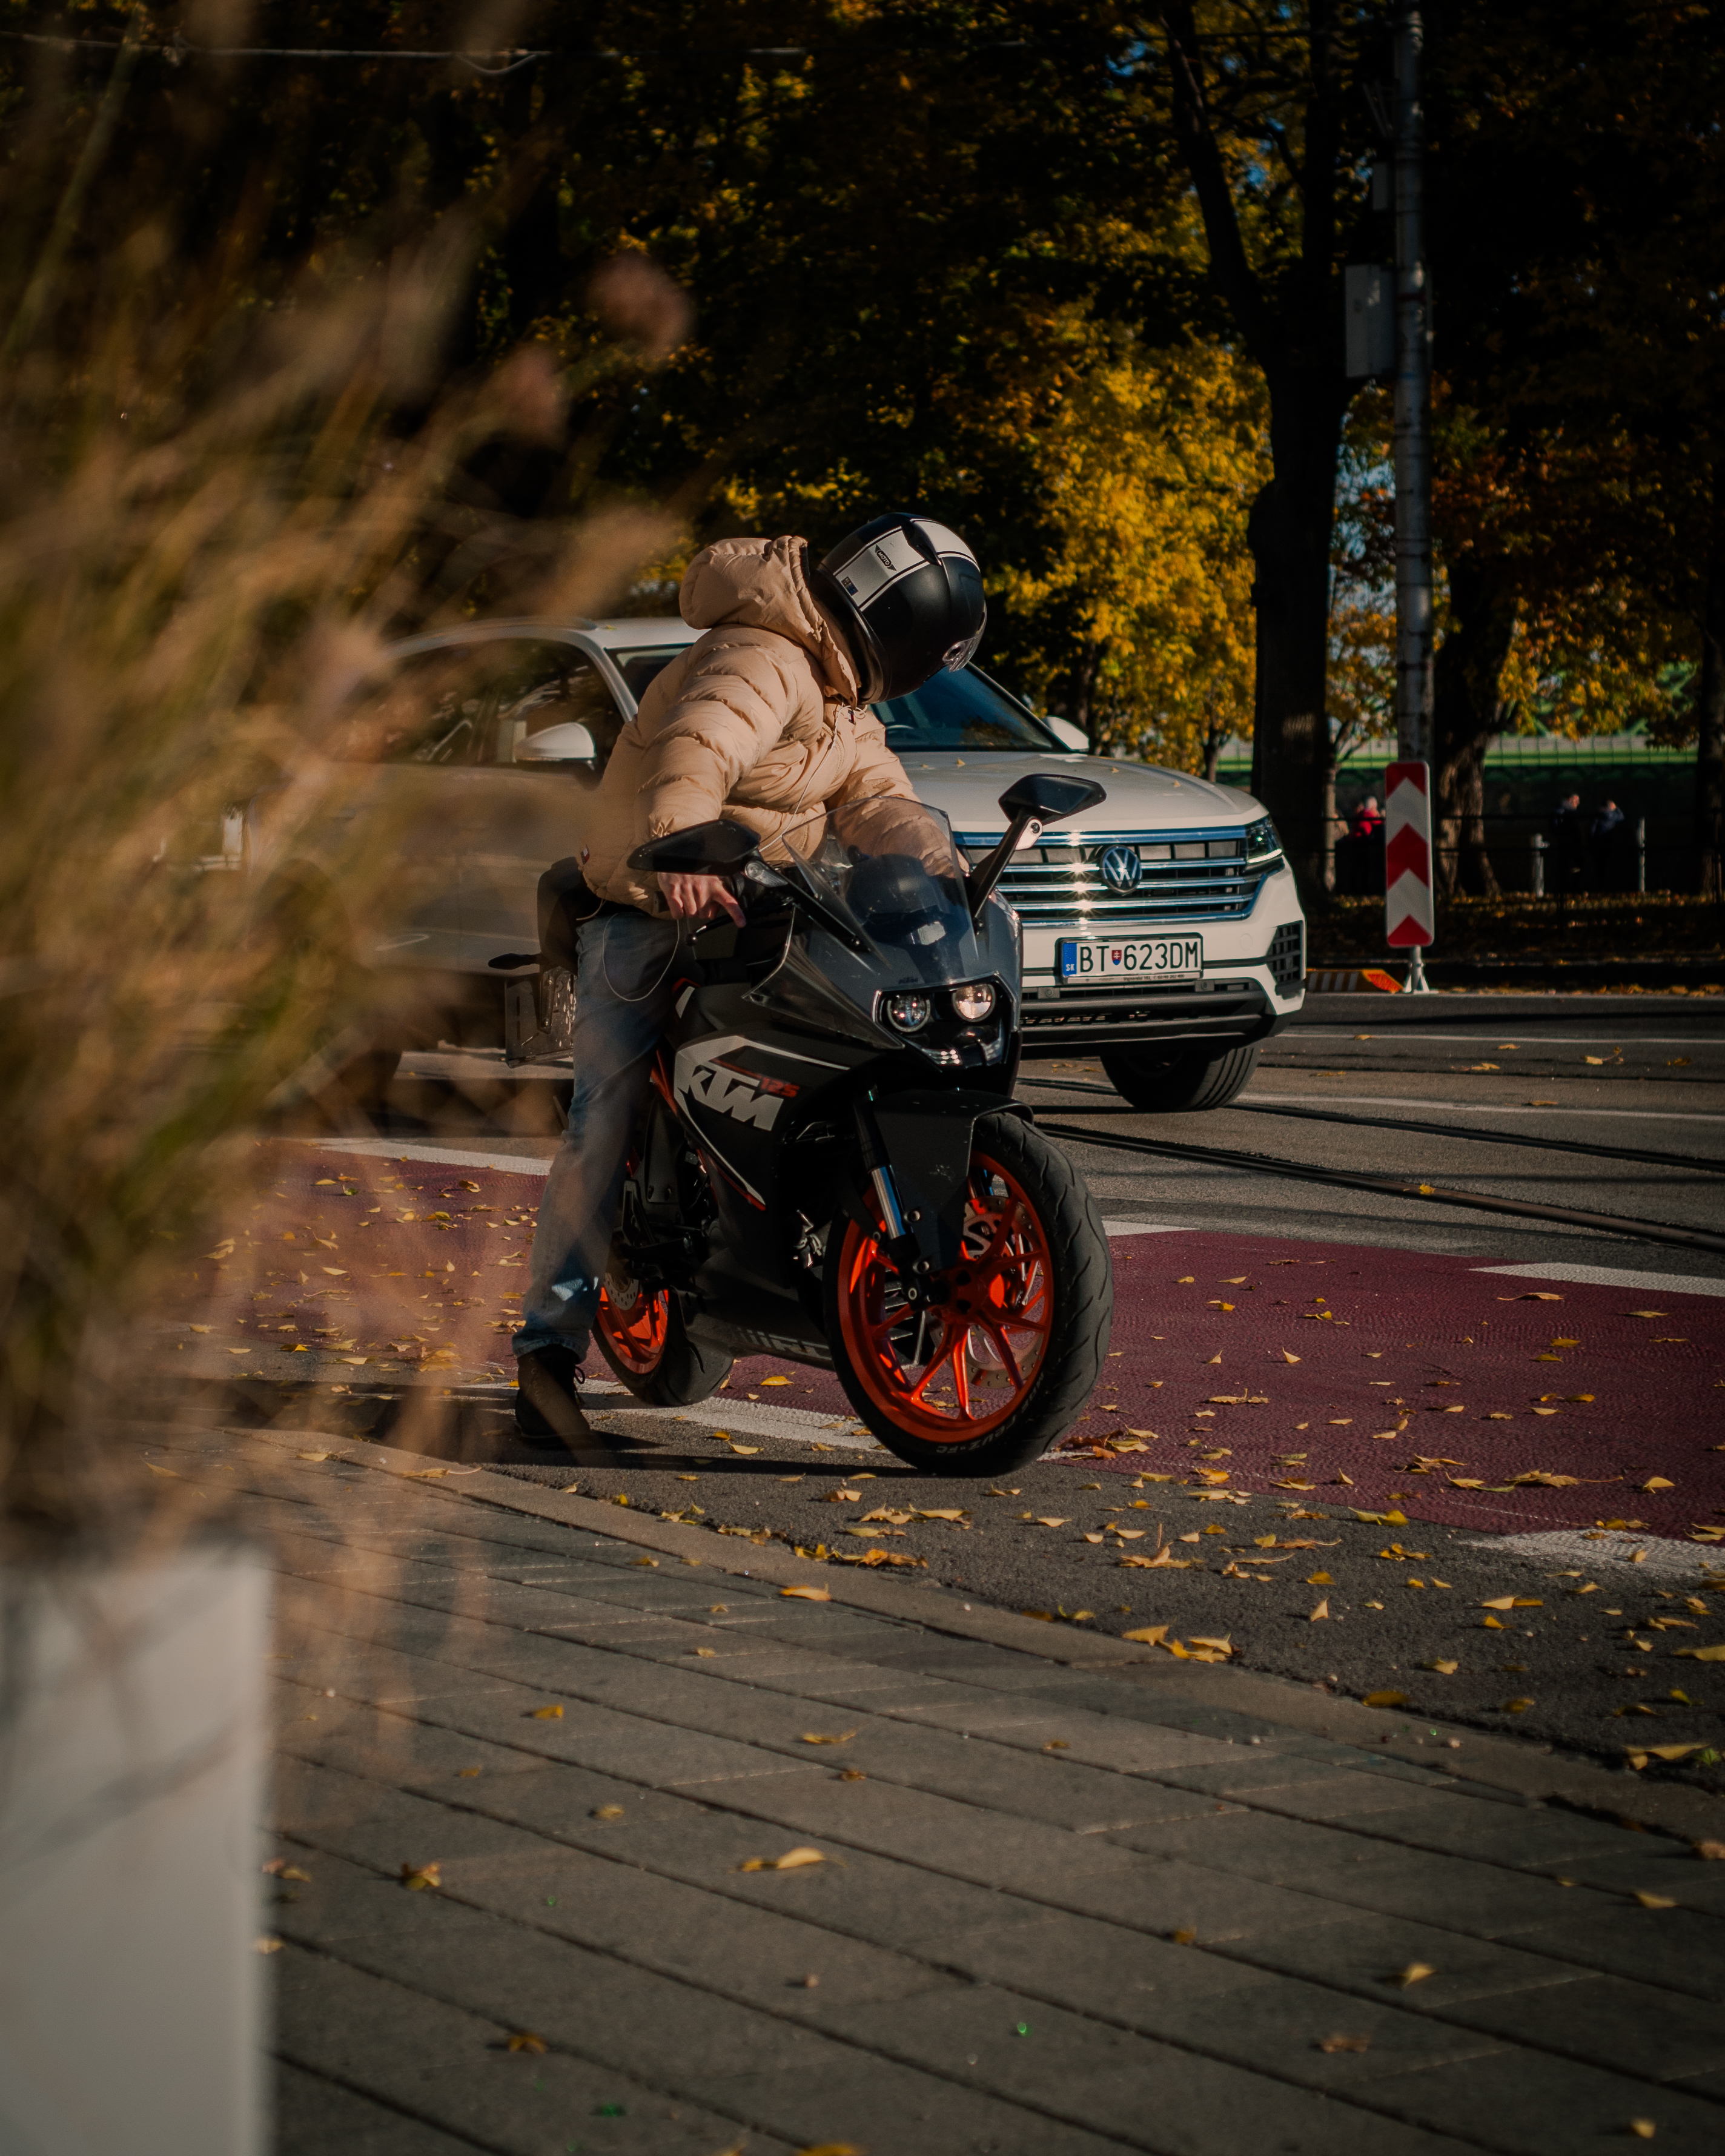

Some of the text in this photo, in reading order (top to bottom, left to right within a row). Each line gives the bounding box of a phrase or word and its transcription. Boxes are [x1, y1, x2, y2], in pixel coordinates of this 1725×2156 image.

[878, 550, 891, 567] MOTO
[1080, 941, 1198, 973] BT 623DM
[678, 1061, 784, 1132] KTM
[760, 1076, 801, 1098] 125
